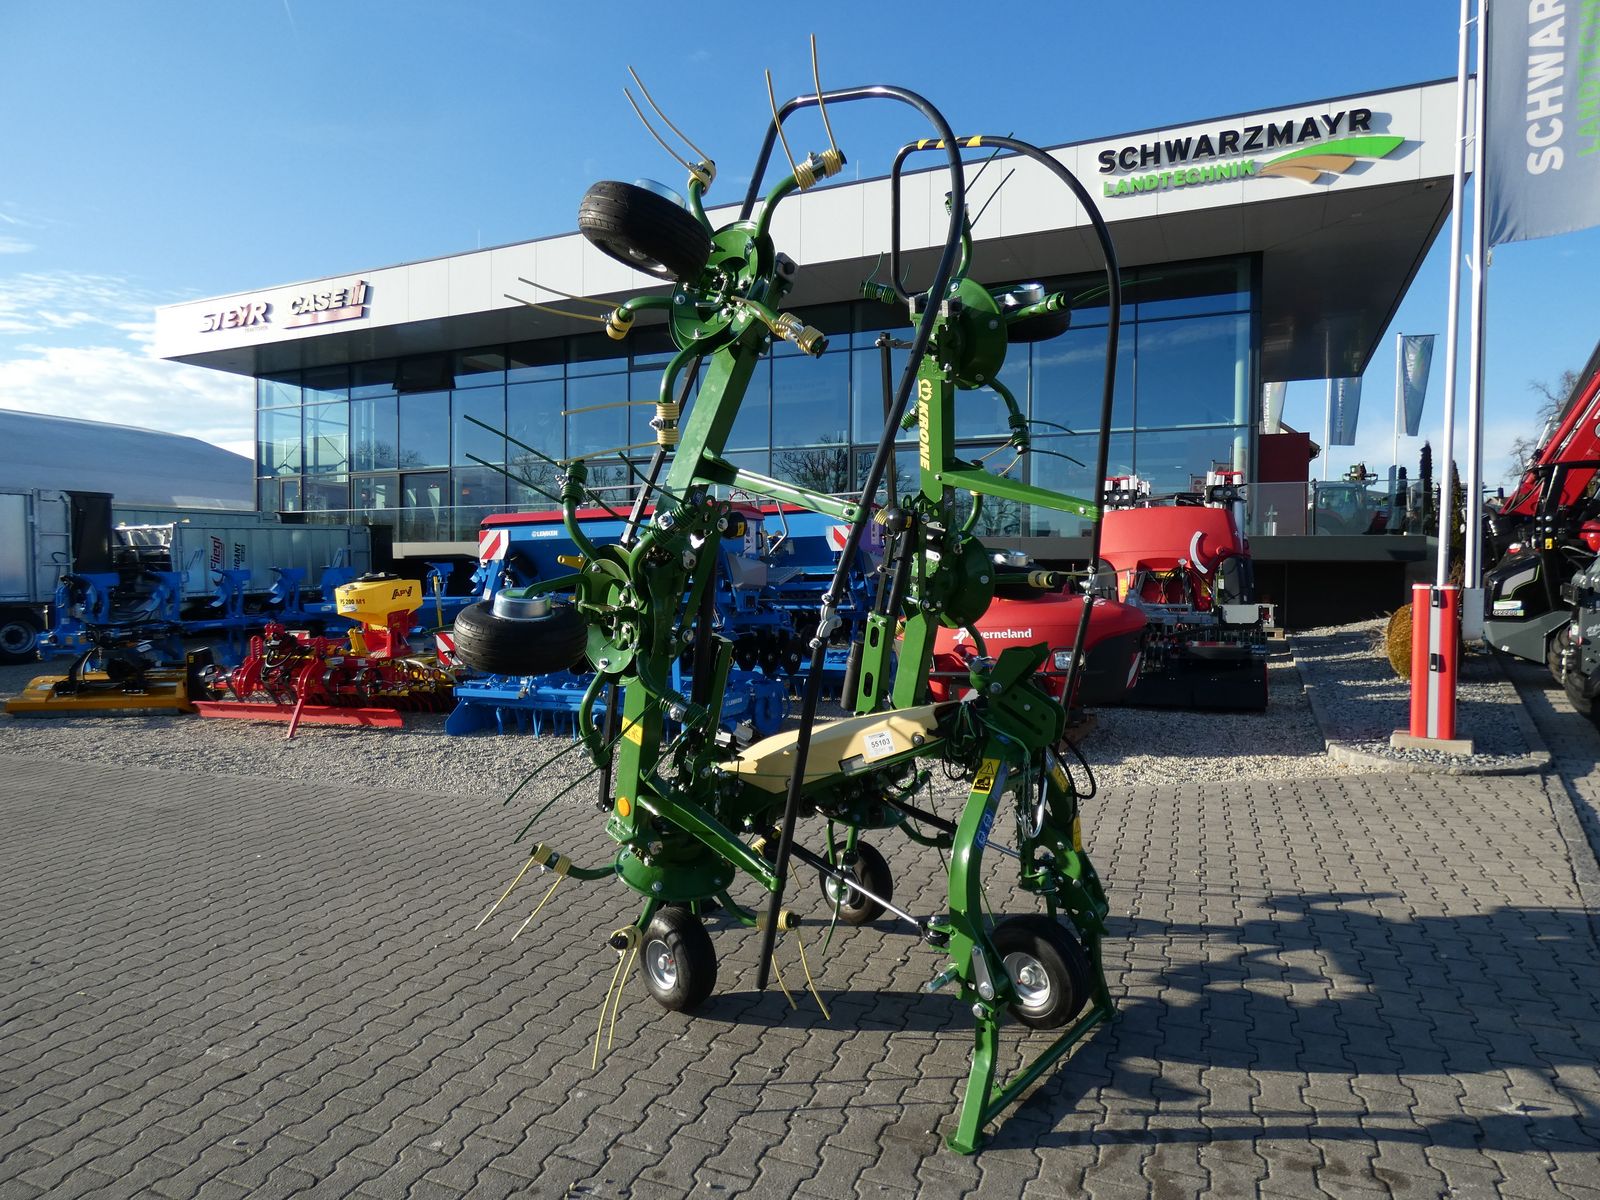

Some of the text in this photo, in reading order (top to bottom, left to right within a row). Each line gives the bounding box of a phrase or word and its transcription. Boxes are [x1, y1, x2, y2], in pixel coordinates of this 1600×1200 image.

[1098, 108, 1372, 173] SCHWARZMAYR
[1104, 159, 1255, 197] LANDTECHNIK
[200, 302, 270, 333] STEYR
[290, 289, 347, 315] CASE
[919, 400, 930, 471] KRONE
[971, 628, 1032, 639] erneland
[871, 738, 890, 749] 55103
